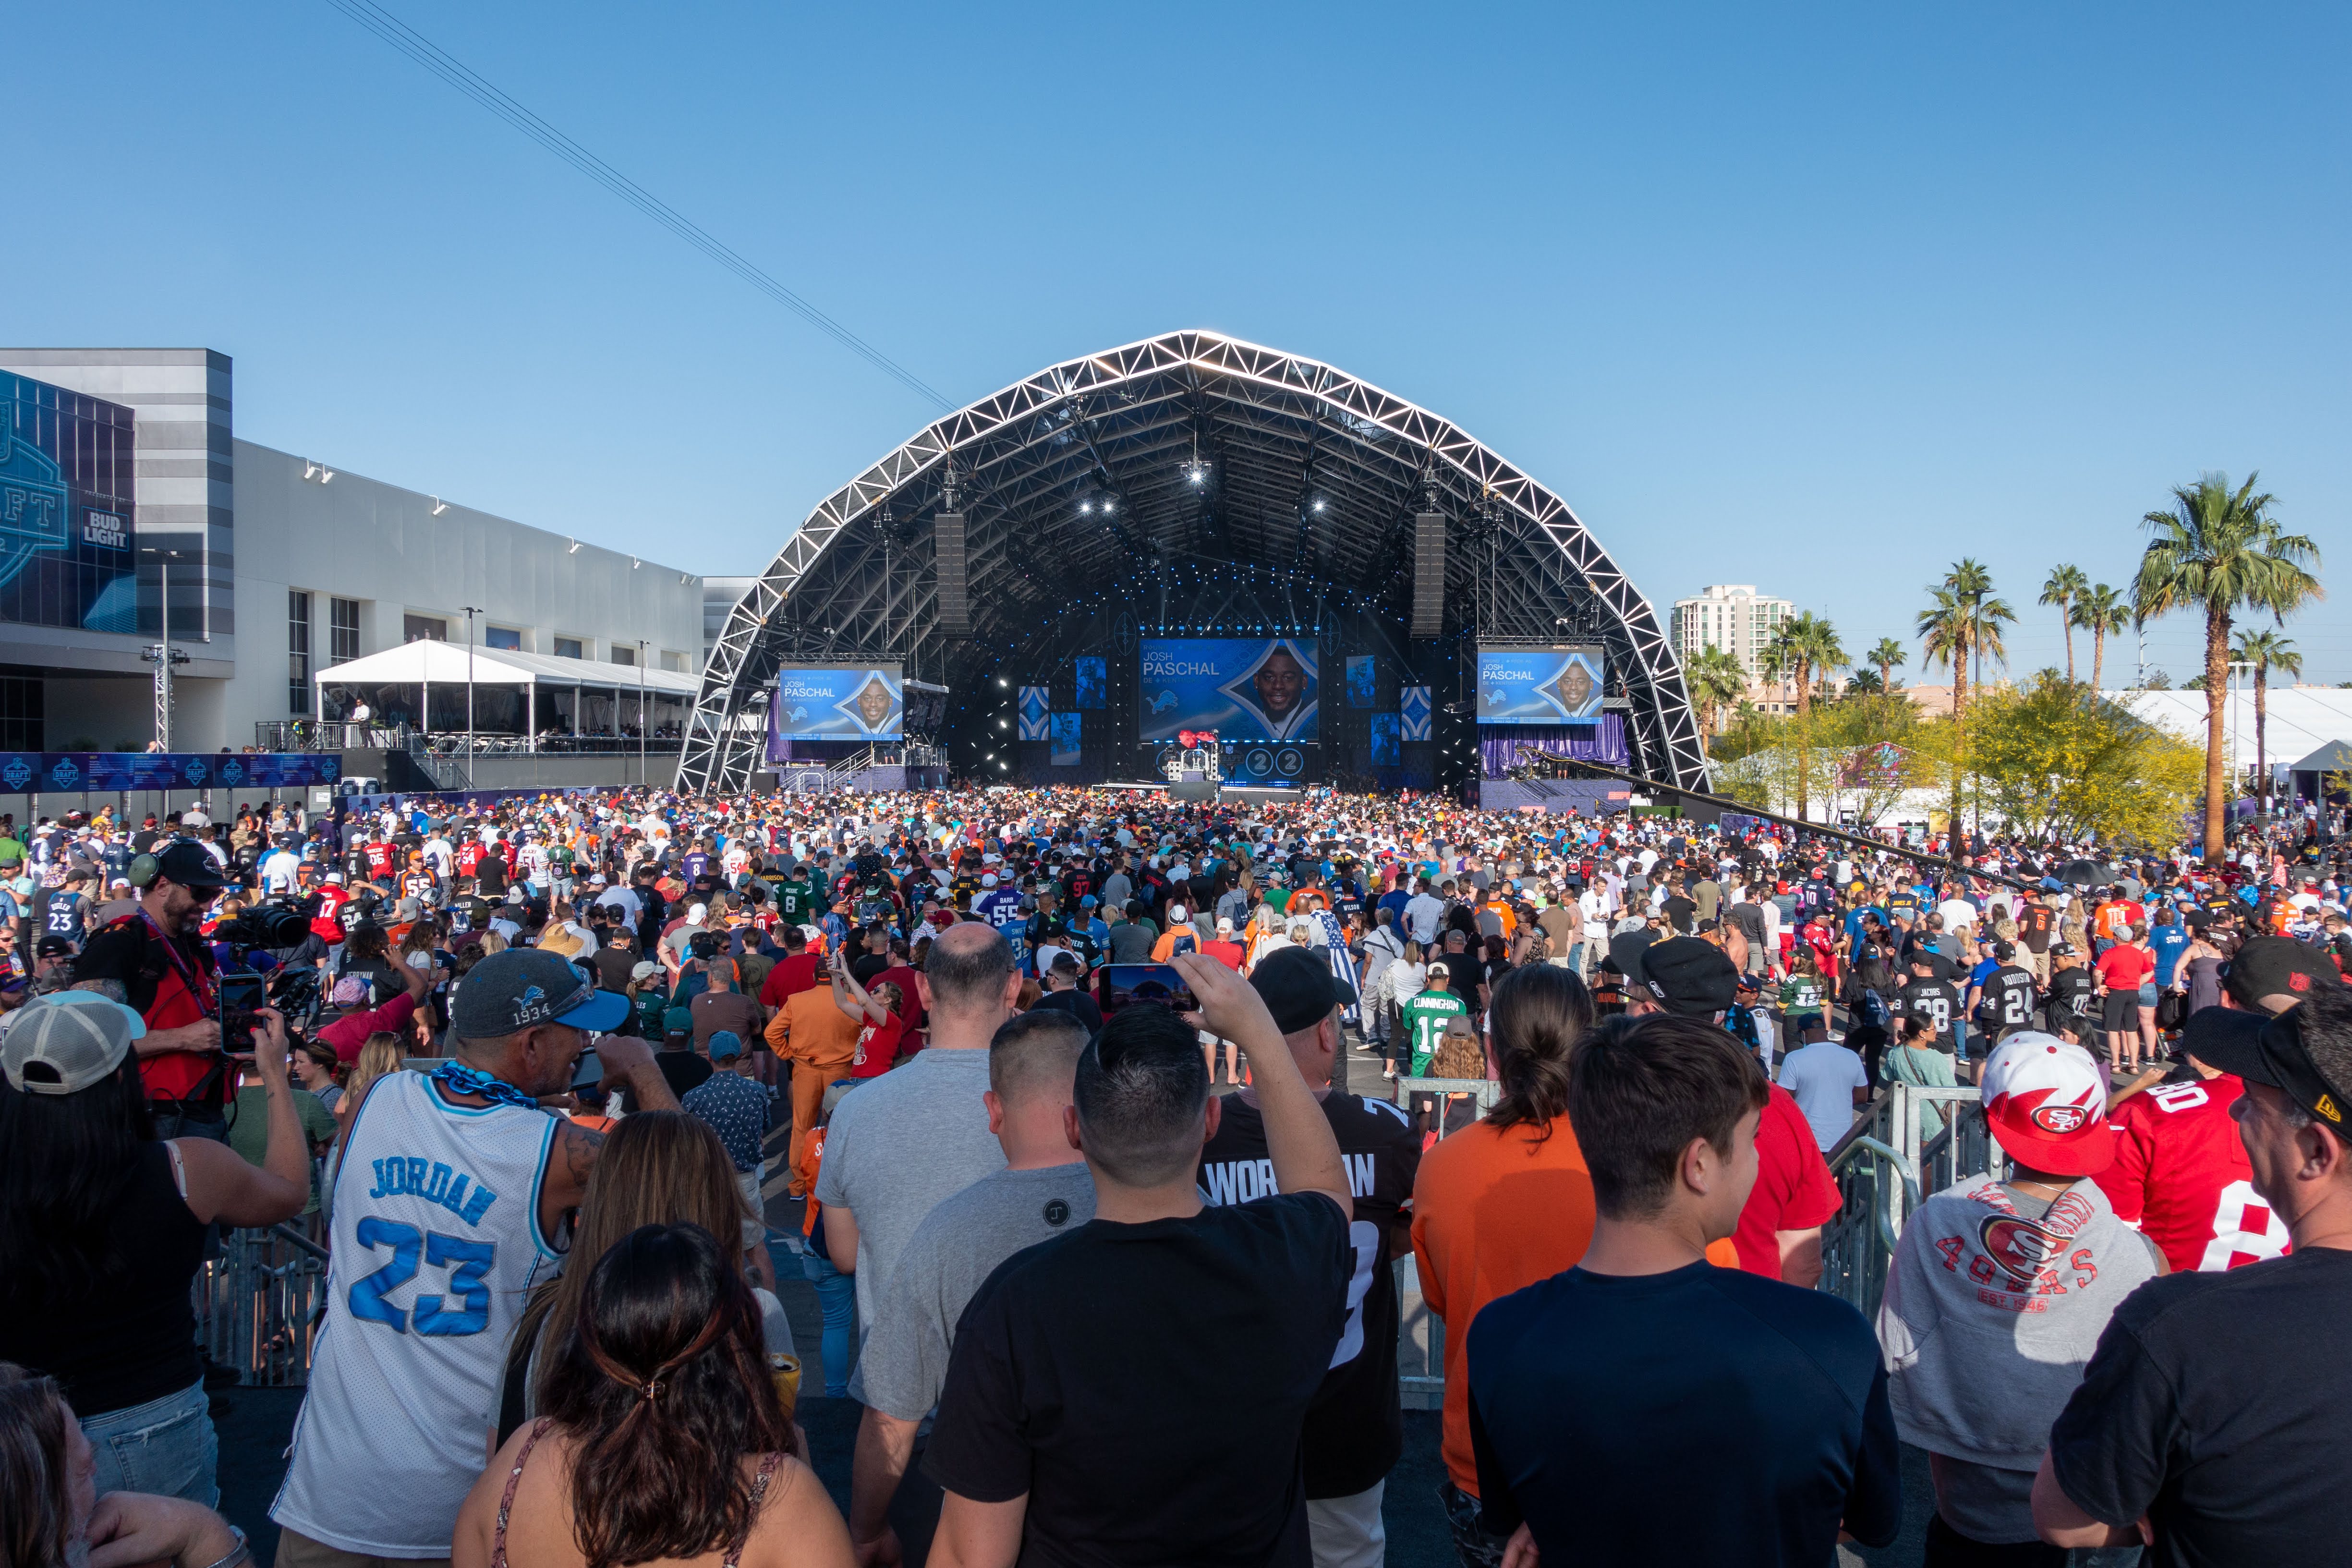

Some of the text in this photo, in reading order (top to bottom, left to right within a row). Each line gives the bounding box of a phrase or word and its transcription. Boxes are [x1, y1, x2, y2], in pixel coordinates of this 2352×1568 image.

[90, 512, 120, 531] BUD
[84, 526, 126, 547] LIGHT
[1143, 652, 1173, 661] JOSH
[1143, 662, 1220, 675] PASCHAL
[1483, 671, 1534, 680] PASCHAL
[785, 688, 835, 697] PASCHAL
[1254, 754, 1296, 769] 2 2
[348, 860, 356, 875] 4
[523, 856, 536, 873] 54
[693, 863, 700, 876] 8
[406, 878, 430, 897] 55
[1073, 881, 1090, 897] 97
[786, 896, 796, 913] 8
[1806, 890, 1817, 906] 10
[48, 913, 72, 931] 23
[993, 905, 1017, 927] 55
[2036, 913, 2046, 930] 6
[1011, 927, 1026, 935] SWIFT
[2166, 936, 2183, 944] STAFF
[2001, 972, 2030, 986] WOODSON
[1921, 988, 1940, 997] JACOBS
[1413, 997, 1459, 1011] CUNNINGHAM
[2004, 986, 2034, 1024] 24
[512, 1003, 551, 1025] 1934
[1418, 1016, 1449, 1053] 12
[369, 1156, 497, 1228] JORDAN
[349, 1215, 497, 1337] 23
[1981, 1290, 2047, 1312] EST. 1946
